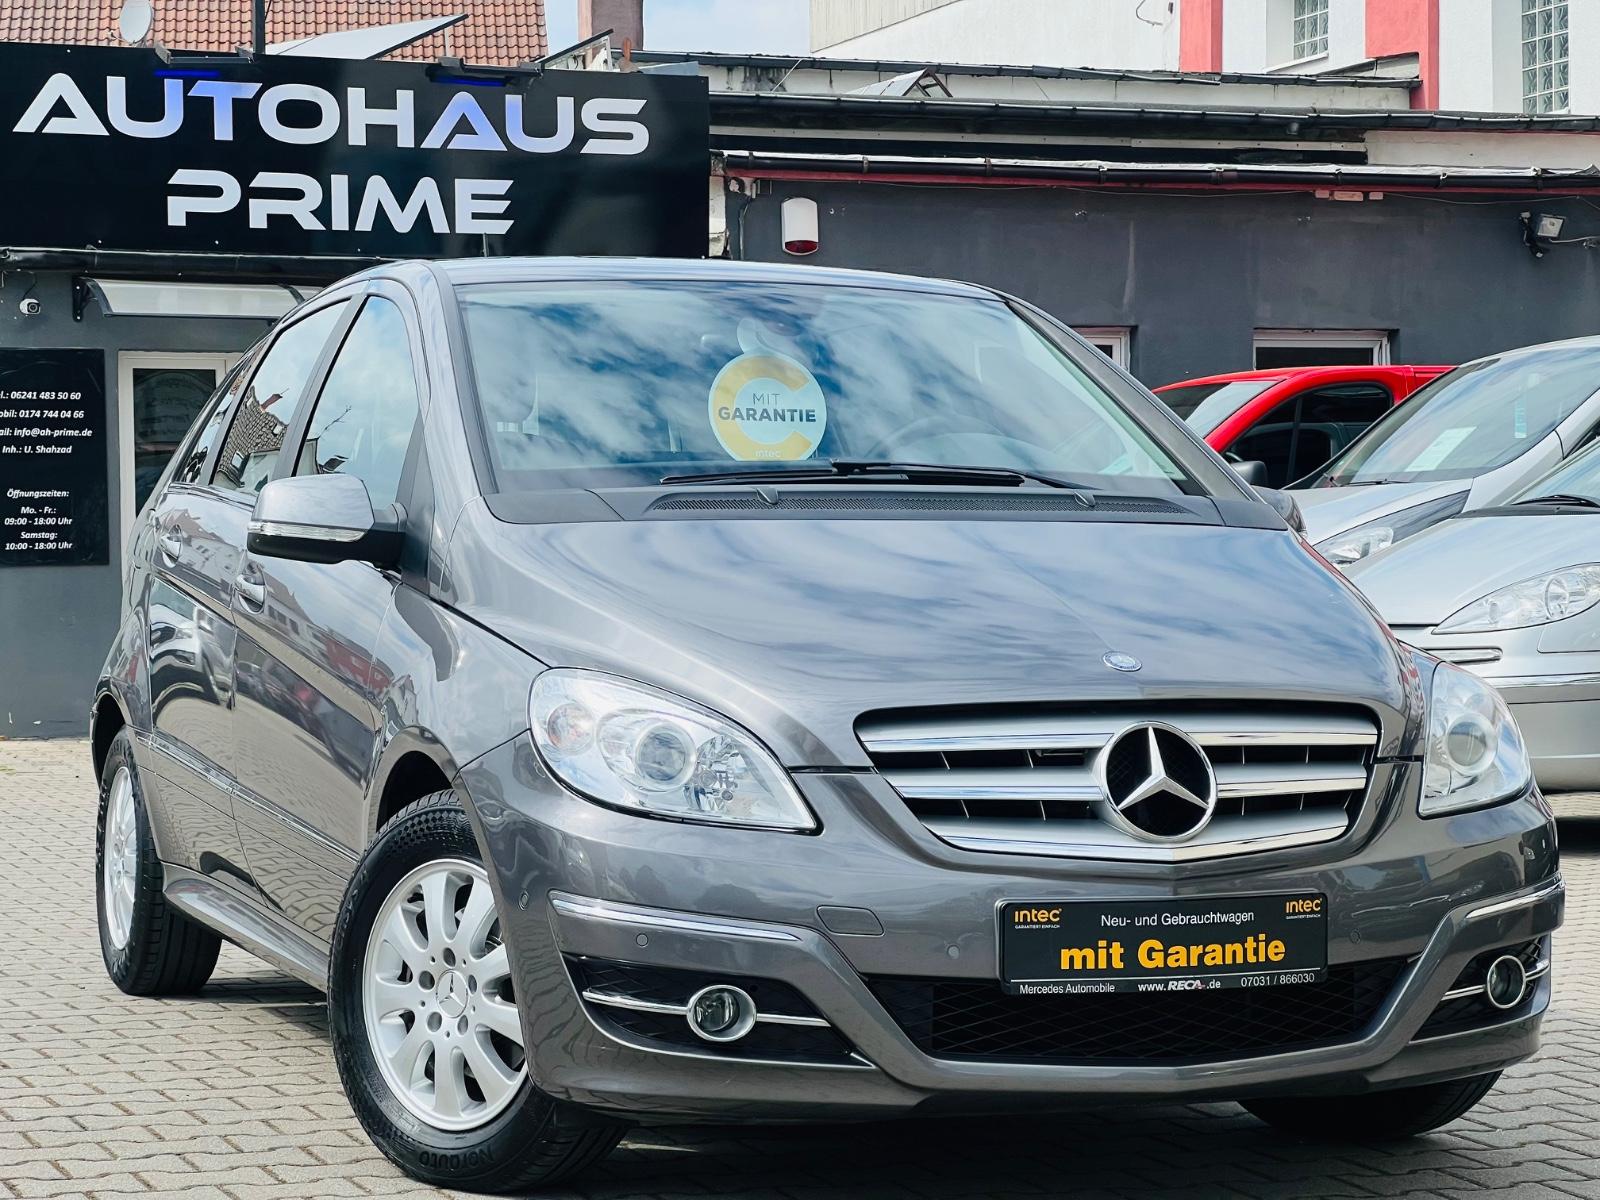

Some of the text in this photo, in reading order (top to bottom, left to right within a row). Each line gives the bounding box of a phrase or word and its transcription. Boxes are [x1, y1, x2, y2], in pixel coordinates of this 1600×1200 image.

[13, 72, 650, 156] AUTOHAUS
[167, 168, 514, 235] PRIME
[10, 391, 37, 400] 06241
[39, 391, 56, 400] 483
[57, 391, 69, 400] 50
[70, 392, 82, 401] 60
[752, 392, 780, 405] MIT
[0, 409, 85, 419] obil: 0174 744 04 66
[718, 406, 816, 423] GARANTIE
[13, 427, 93, 438] info@ah-prime.de
[2, 445, 73, 454] Inh.: U. Shahzad
[6, 488, 70, 499] Öffnungszeiten:
[20, 506, 37, 514] Mo.
[43, 506, 57, 514] Fr.:
[4, 517, 28, 526] 09:00
[33, 517, 57, 526] 18:00
[57, 517, 73, 525] Uhr
[20, 531, 58, 541] Samstag:
[5, 542, 28, 551] 10:00
[34, 542, 57, 550] 18:00
[58, 541, 73, 550] Uhr
[1285, 899, 1322, 914] intec
[1014, 908, 1062, 923] intec
[1100, 911, 1255, 927] Neu- und Gebrauchtwagen
[1060, 933, 1286, 970] mit Garantie
[1240, 976, 1271, 988] 07031
[1279, 972, 1316, 985] 866030
[1019, 983, 1116, 994] Mercedes Automobile
